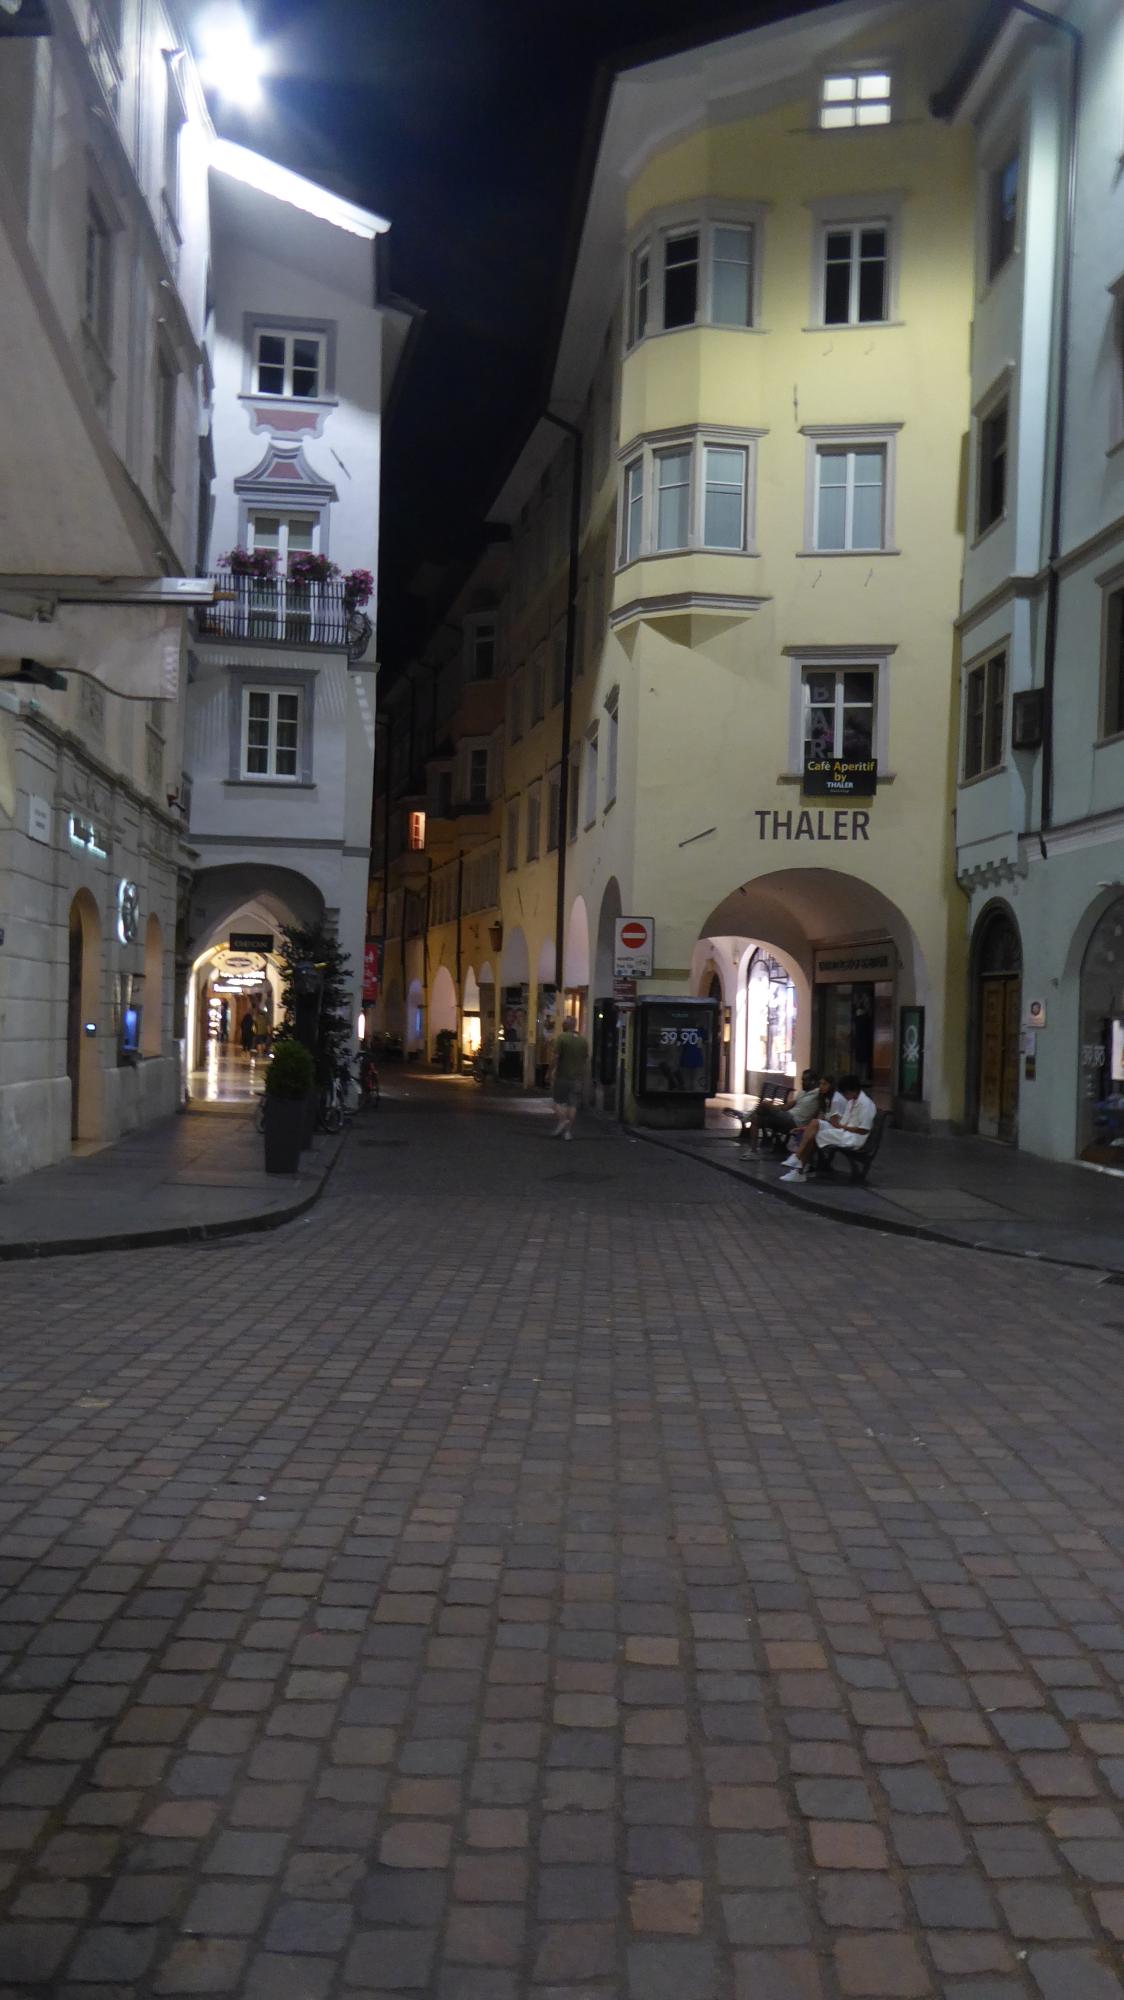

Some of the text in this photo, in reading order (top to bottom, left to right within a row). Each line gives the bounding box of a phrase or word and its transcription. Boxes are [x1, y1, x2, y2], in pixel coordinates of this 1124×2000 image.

[834, 772, 847, 783] by
[826, 781, 854, 789] THALER
[754, 810, 870, 840] THALER
